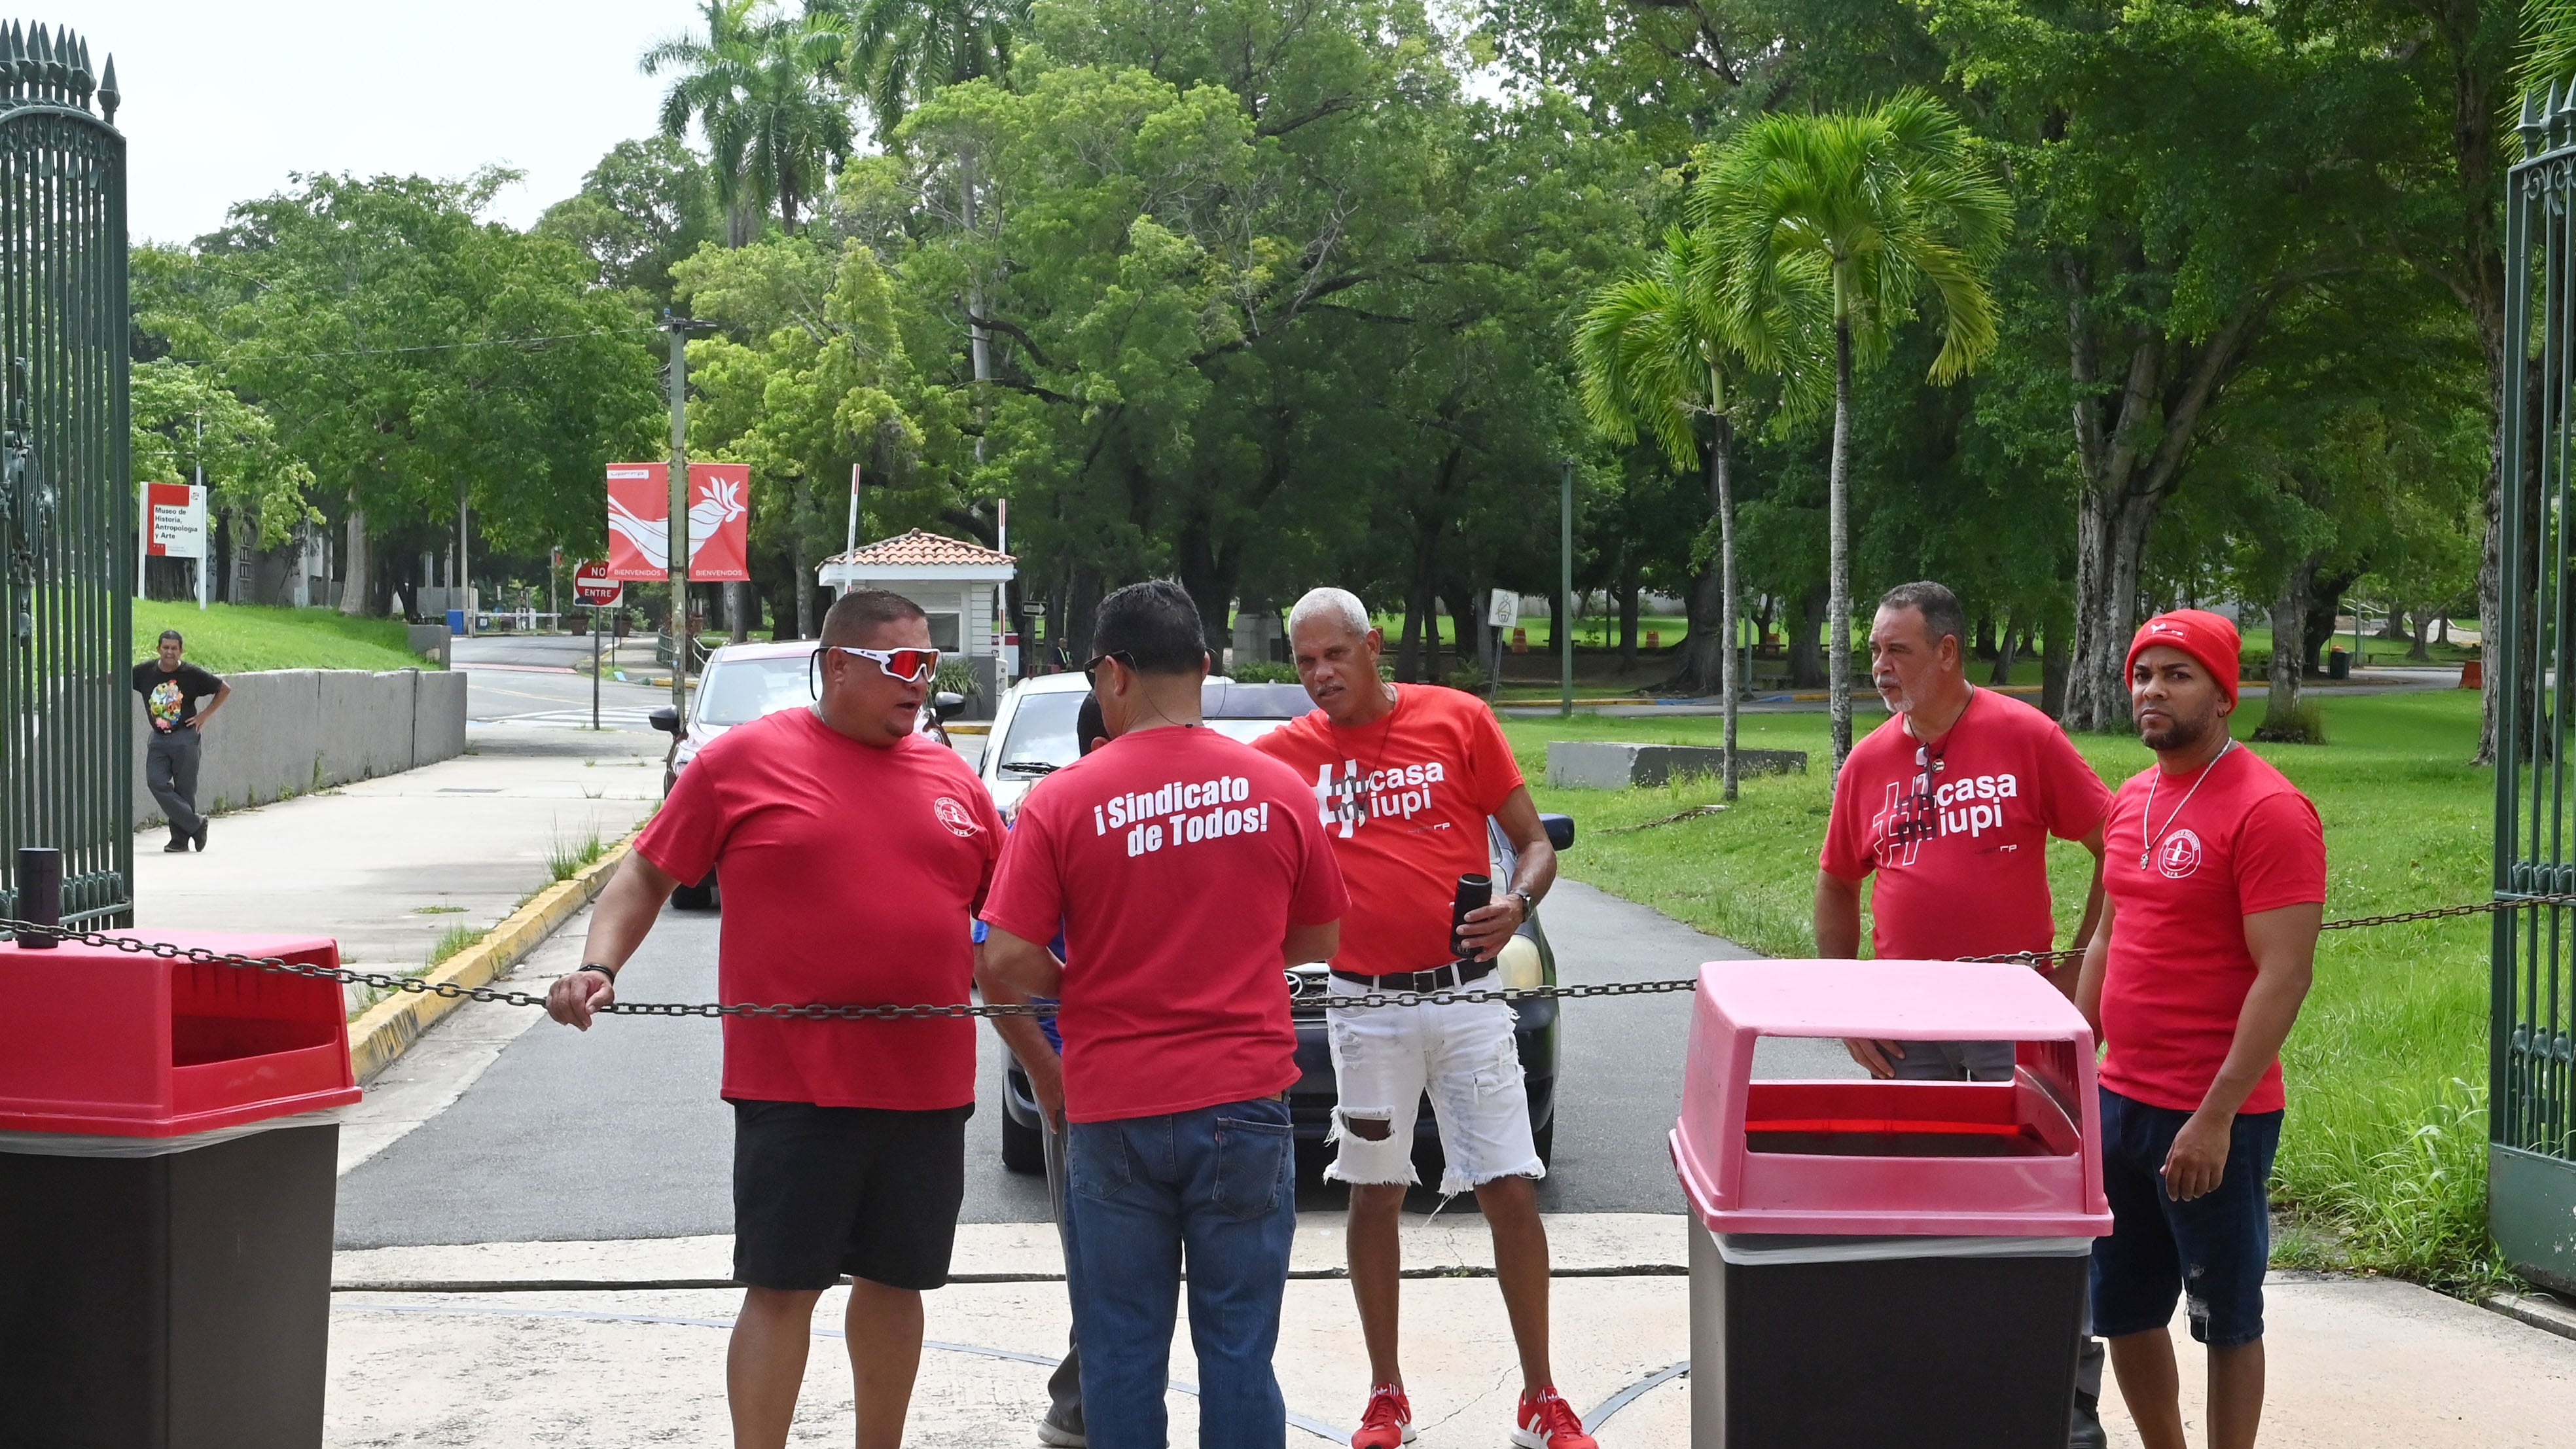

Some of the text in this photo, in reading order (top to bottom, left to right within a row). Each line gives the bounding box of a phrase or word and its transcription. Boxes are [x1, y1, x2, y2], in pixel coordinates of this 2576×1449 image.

[591, 567, 606, 577] NO
[584, 588, 612, 598] ENTRE
[1094, 776, 1249, 836] ¡Sindicato
[1127, 802, 1268, 857] de Todos!
